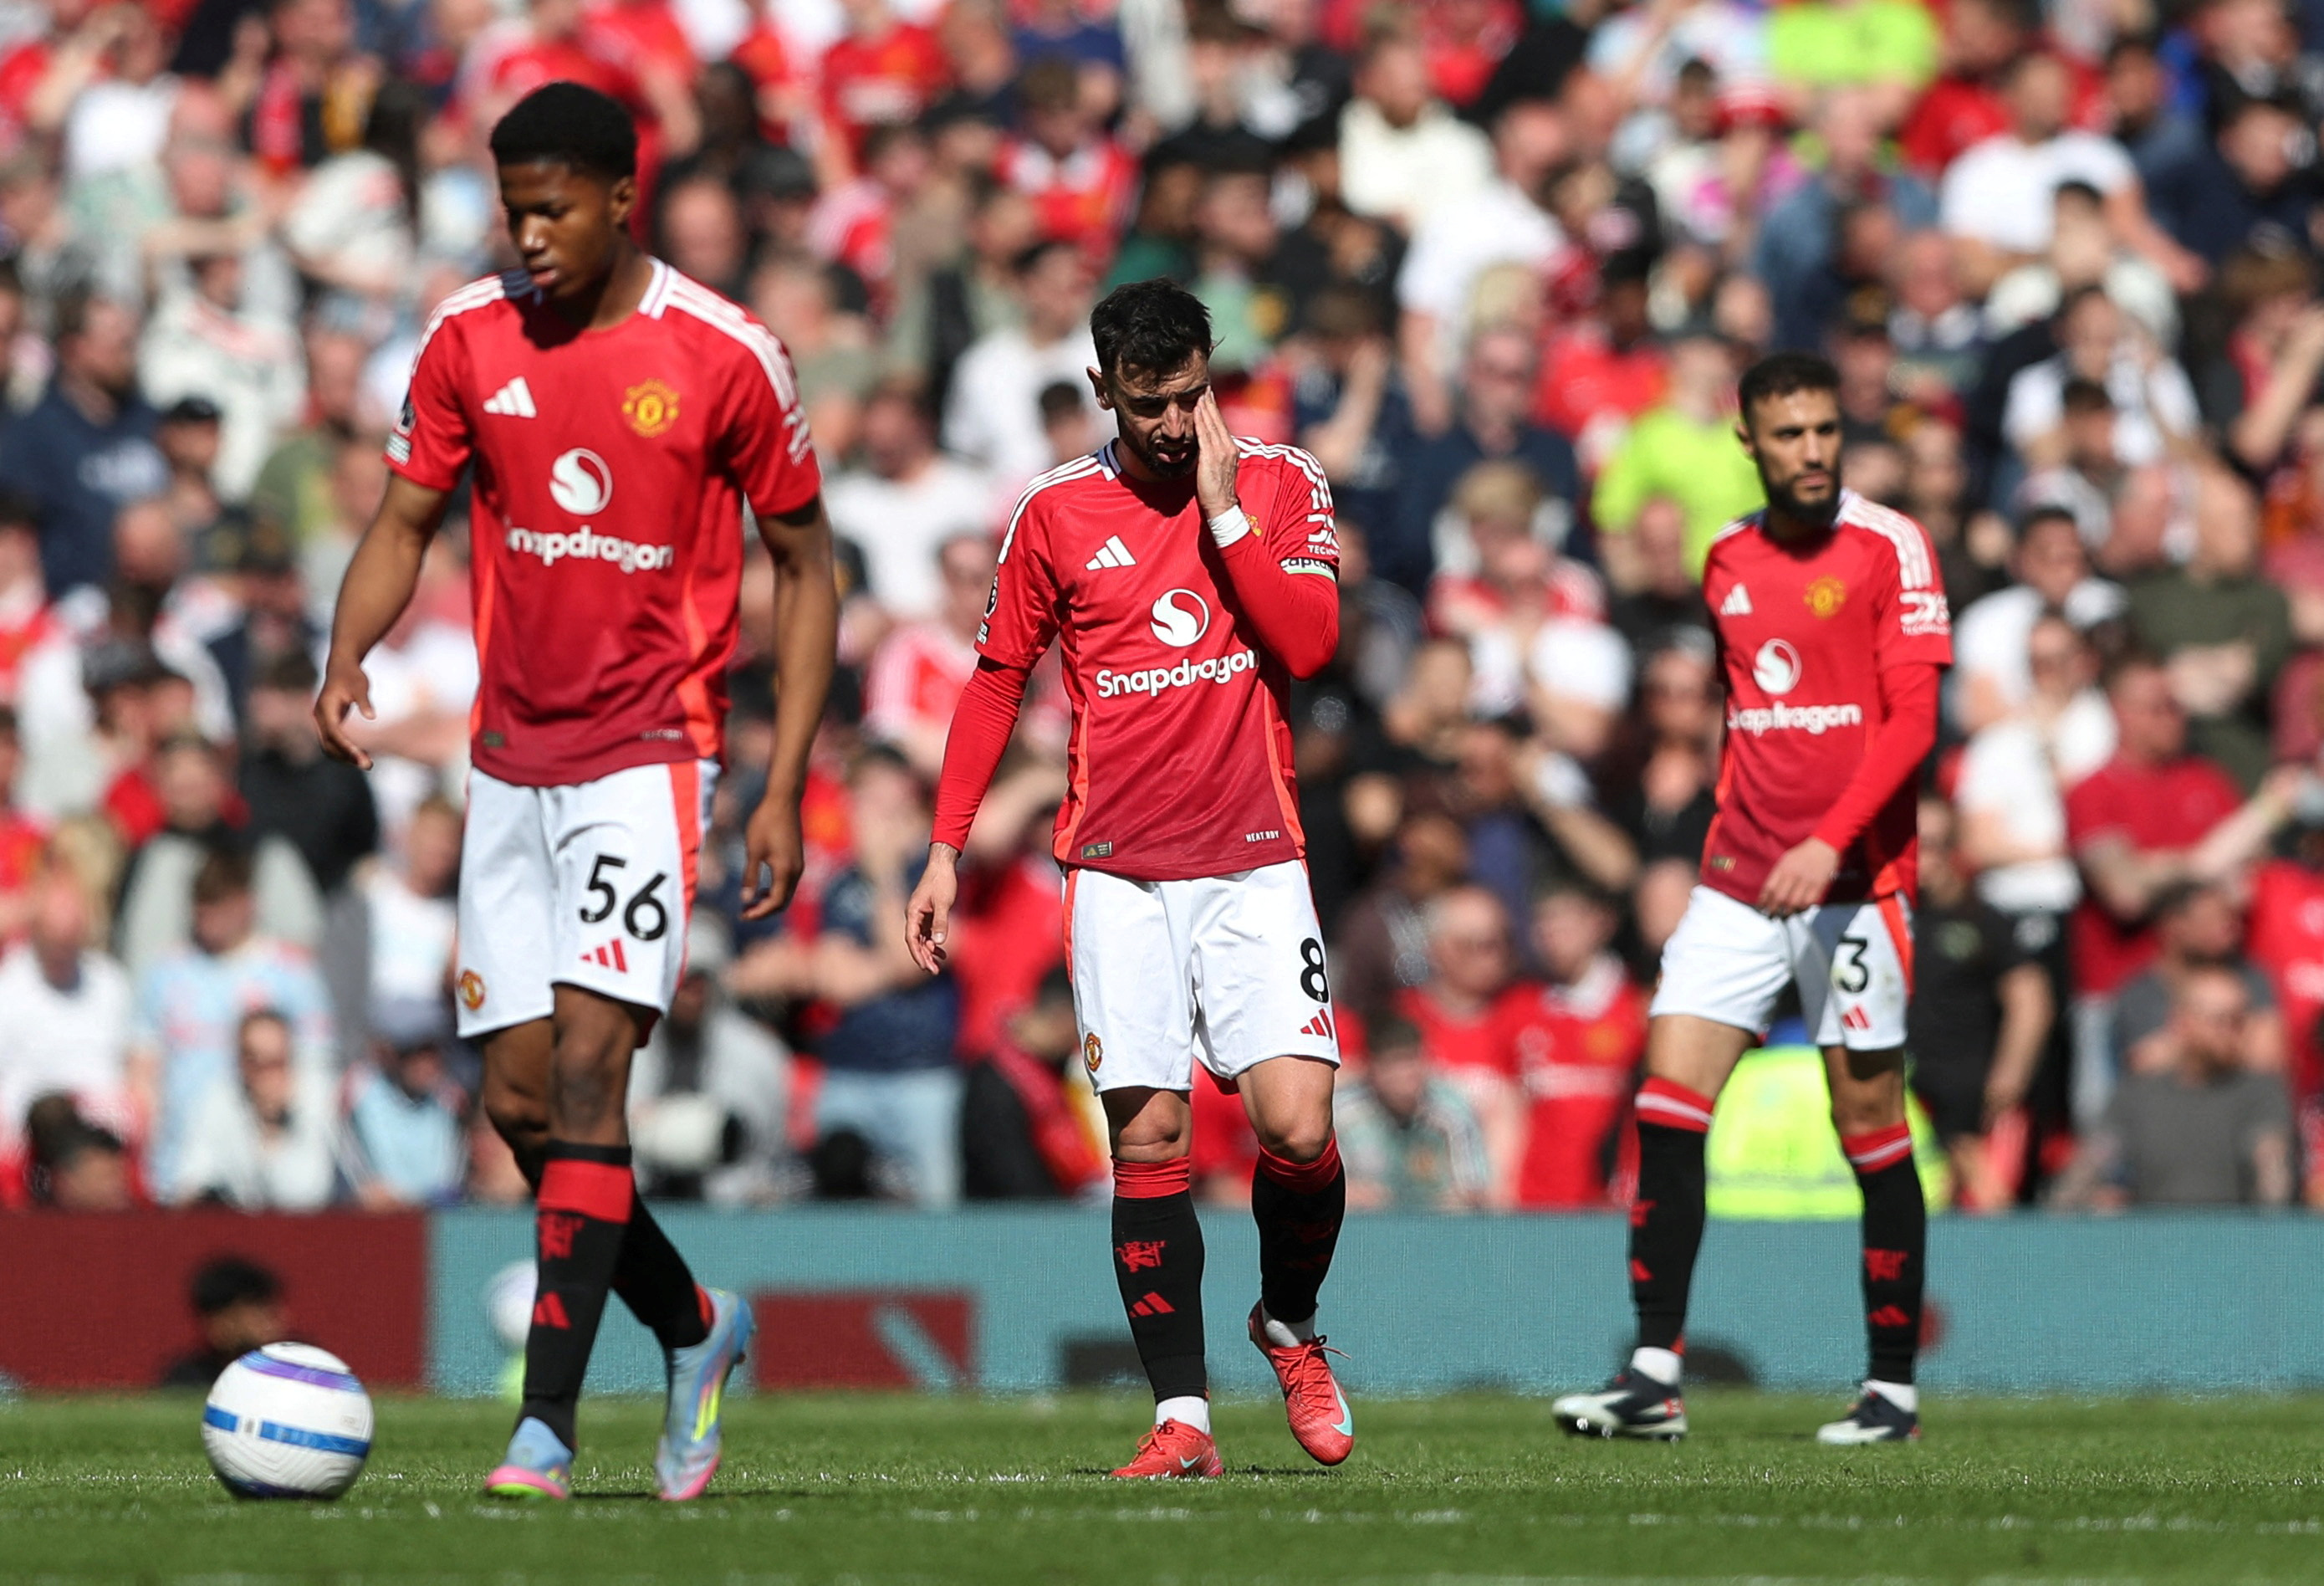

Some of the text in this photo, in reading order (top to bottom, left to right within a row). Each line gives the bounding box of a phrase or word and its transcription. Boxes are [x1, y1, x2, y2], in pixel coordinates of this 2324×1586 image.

[580, 853, 668, 942] 56
[1300, 937, 1330, 1004] 8
[1839, 936, 1869, 994] 3
